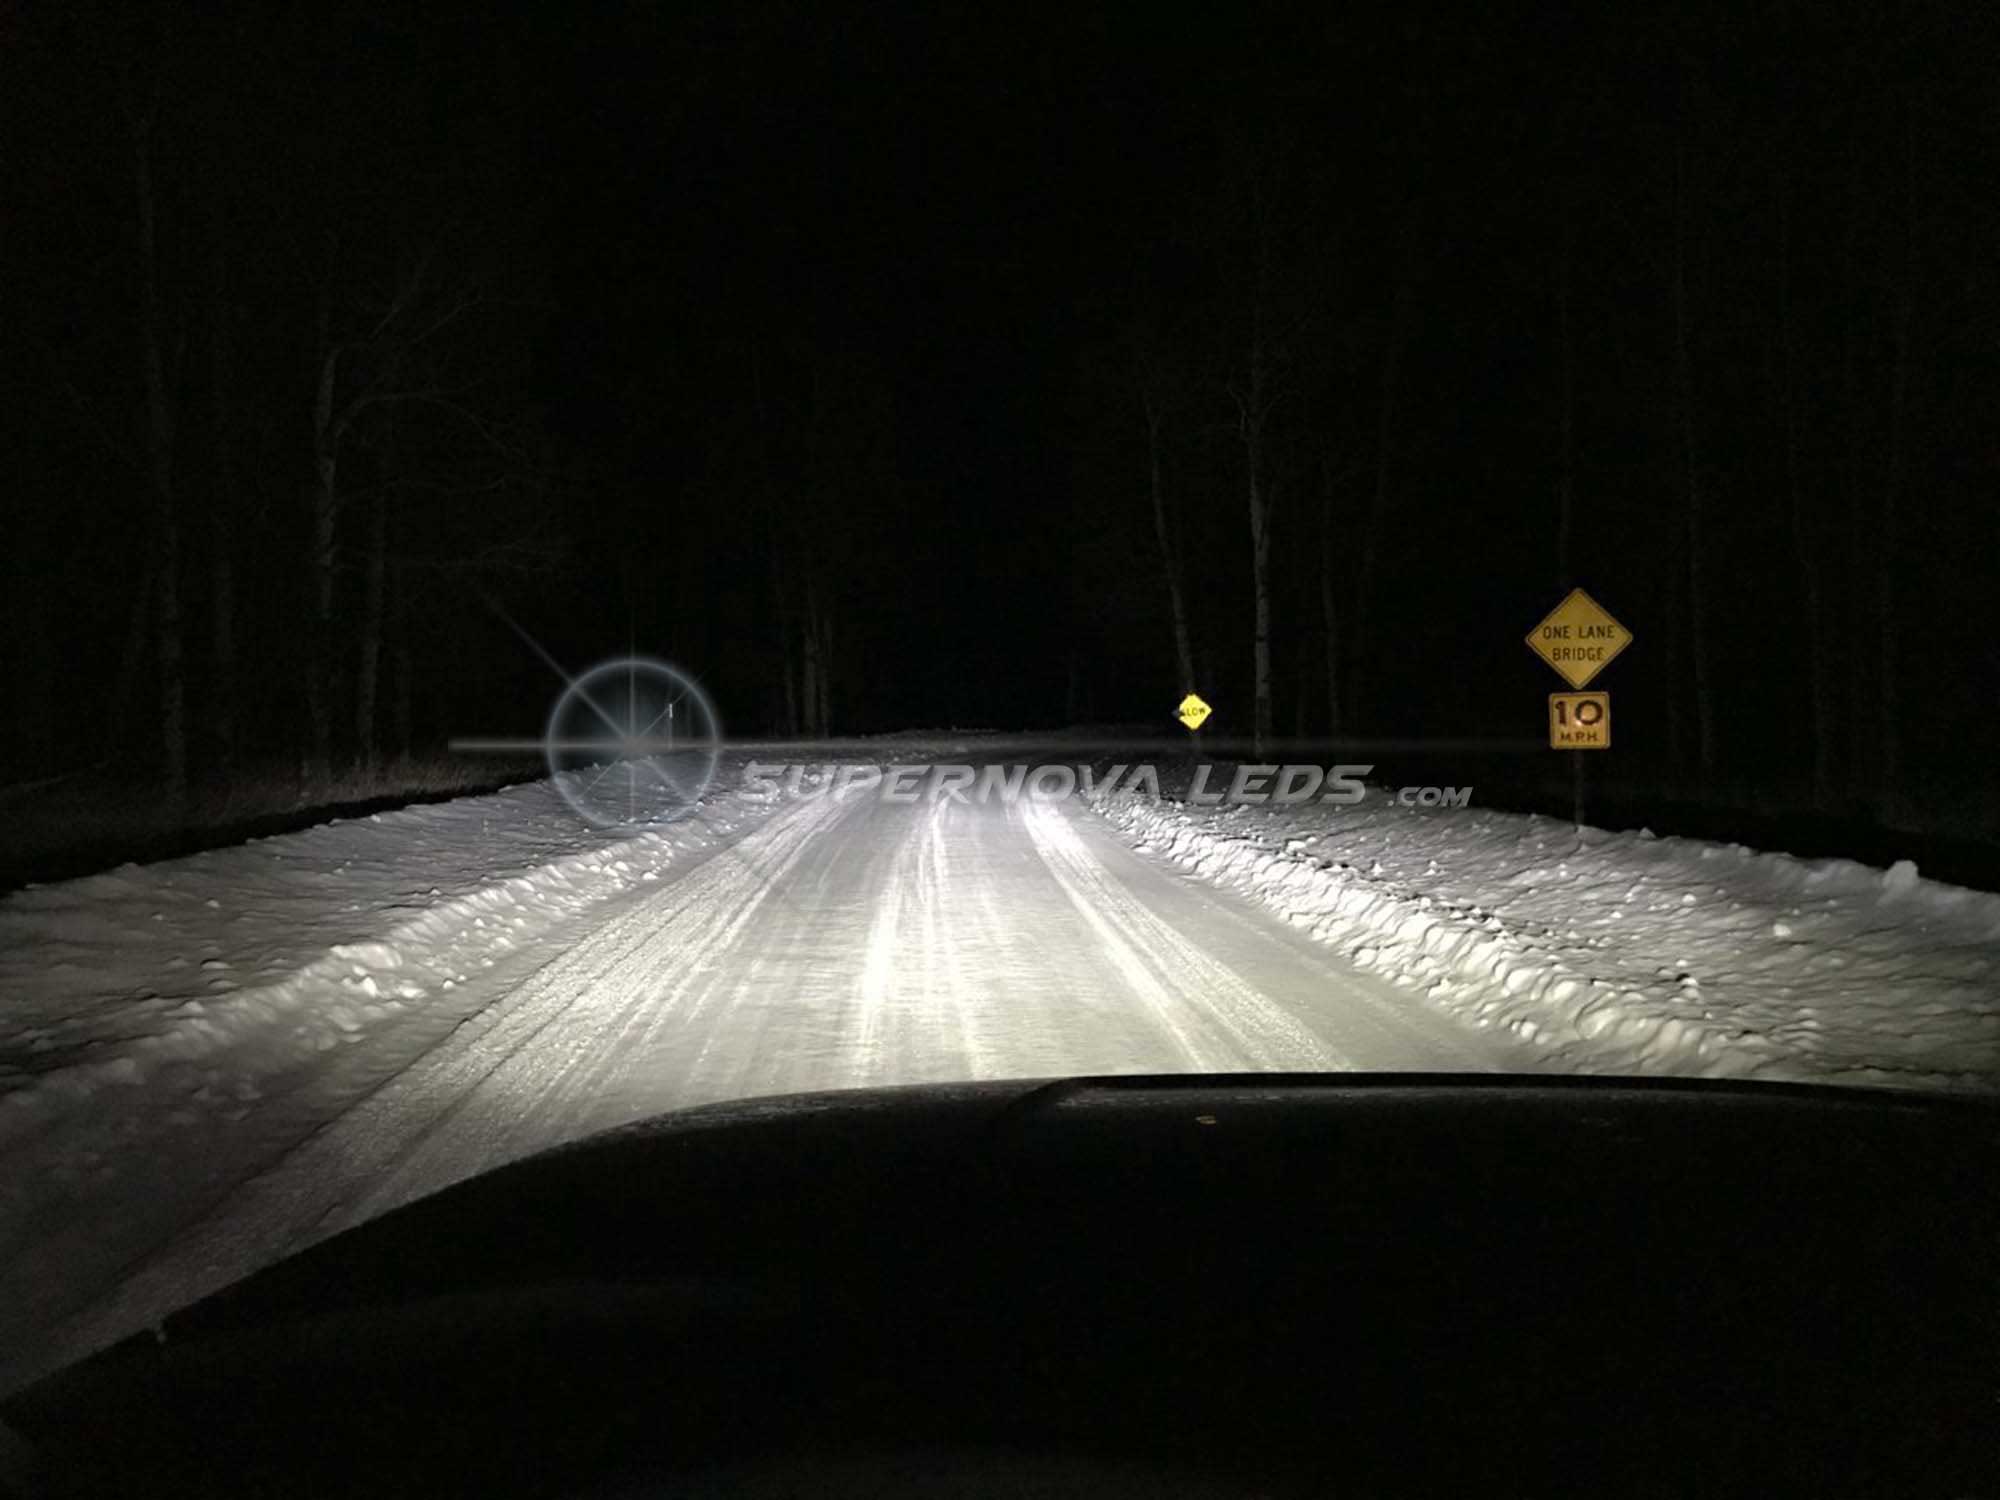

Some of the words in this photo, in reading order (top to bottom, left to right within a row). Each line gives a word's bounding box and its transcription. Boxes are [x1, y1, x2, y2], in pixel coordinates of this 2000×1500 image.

[1543, 625, 1570, 640] ONE
[1578, 625, 1615, 639] LANE
[1552, 648, 1604, 662] BRIDGE
[1555, 700, 1603, 726] 10
